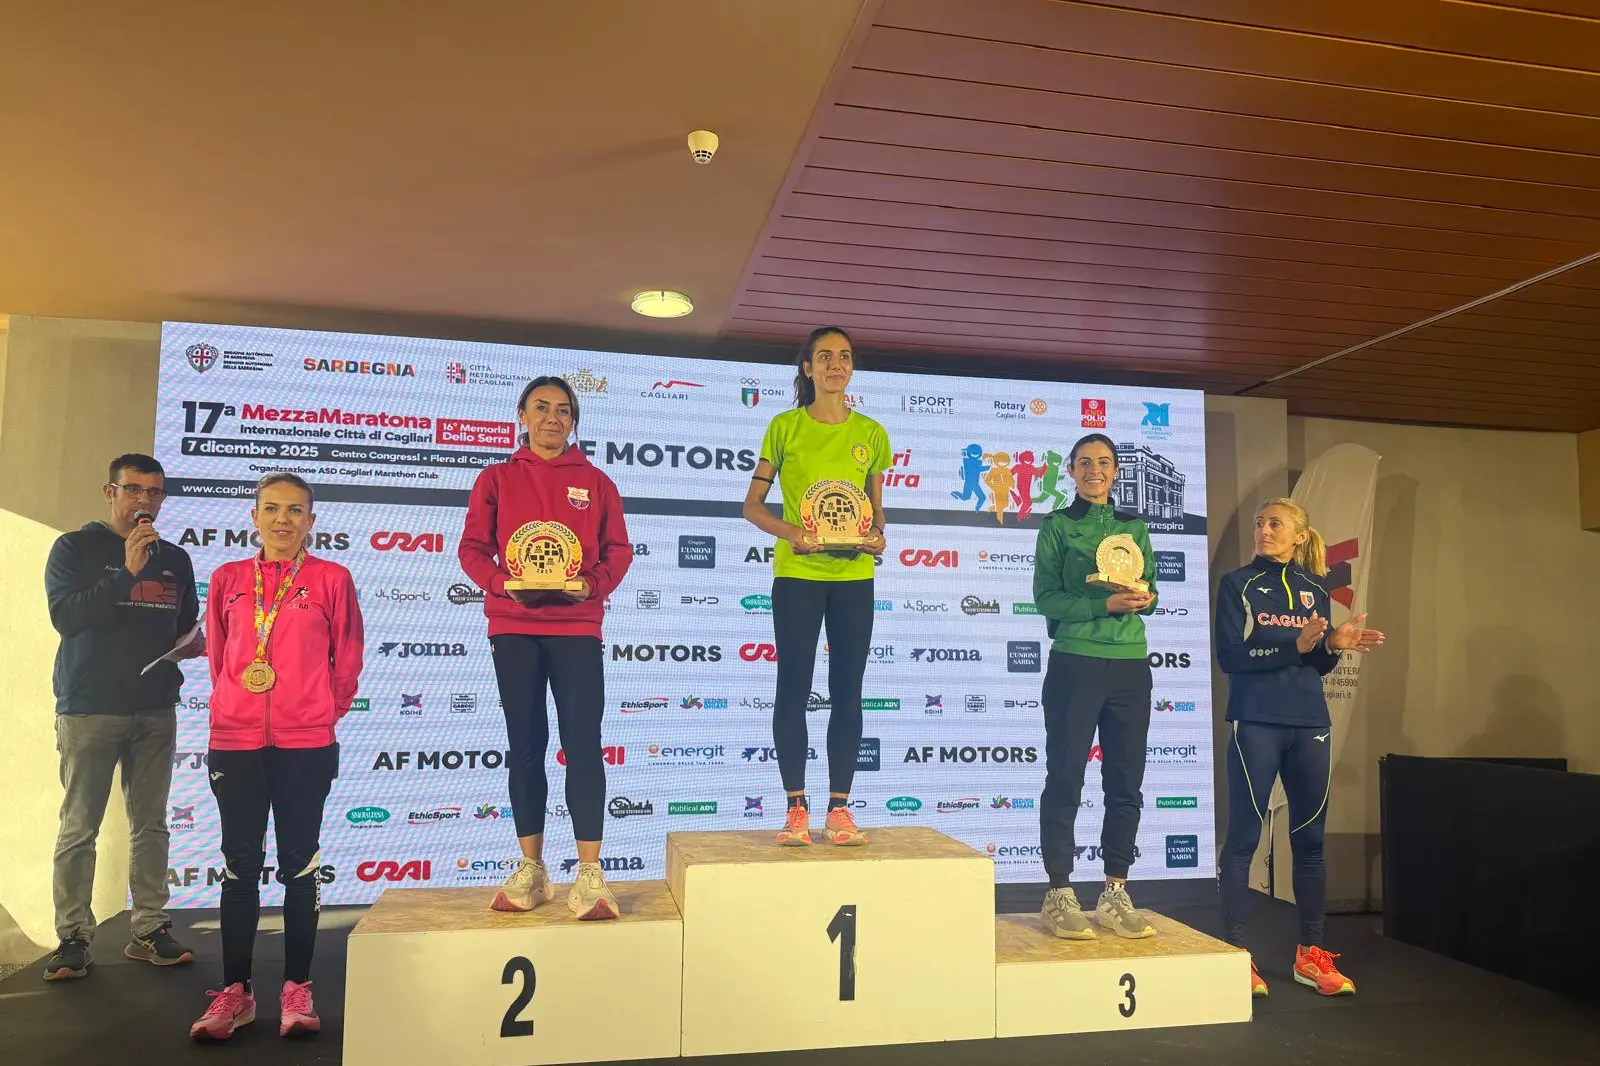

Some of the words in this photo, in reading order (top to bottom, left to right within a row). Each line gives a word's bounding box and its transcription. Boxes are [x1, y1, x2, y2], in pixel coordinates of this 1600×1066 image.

[303, 357, 415, 377] SARDEGNA
[469, 372, 531, 382] METROPOLITANA
[480, 379, 514, 387] CAGLIARI
[641, 391, 688, 400] CAGLIARI
[761, 388, 785, 396] CONI
[910, 395, 954, 407] SPORT
[993, 400, 1026, 412] Rotary
[241, 403, 432, 430] MezzaMaratona
[1081, 414, 1106, 422] POLIO
[240, 424, 331, 440] Internazionale
[334, 429, 365, 440] Città
[370, 431, 381, 440] di
[384, 432, 432, 445] Cagliari
[460, 424, 510, 434] Memorial
[477, 433, 510, 444] Serra
[188, 440, 197, 451] 7
[200, 440, 277, 456] dicembre
[280, 444, 319, 458] 2025
[331, 449, 368, 459] Centro
[370, 451, 420, 463] Congressi
[430, 454, 456, 463] Fiera
[606, 441, 756, 471] MOTORS
[249, 464, 317, 476] Organizzazione
[318, 467, 338, 475] ASD
[339, 468, 373, 478] Cagliari
[374, 470, 417, 479] Marathon
[178, 528, 218, 546] AF
[370, 531, 444, 553] CRAI
[684, 554, 709, 562] SARDA
[744, 546, 774, 563] AF
[899, 548, 959, 568] CRAI
[391, 589, 431, 603] Sport
[916, 600, 949, 613] Sport
[1257, 612, 1310, 628] CAGLIA
[612, 644, 722, 662] MOTORS
[621, 701, 668, 710] EthicSport
[661, 745, 725, 759] energit
[903, 747, 933, 763] AF
[940, 746, 1037, 763] MOTORS
[1146, 745, 1197, 758] energit
[373, 751, 410, 770] AF
[670, 805, 698, 813] Publical
[937, 801, 980, 810] EthicSport
[408, 811, 461, 821] EthicSport
[167, 868, 199, 887] AF
[356, 860, 432, 882] CRAI
[826, 904, 857, 1002] 1
[500, 956, 537, 1038] 2
[1118, 972, 1137, 1018] 3
